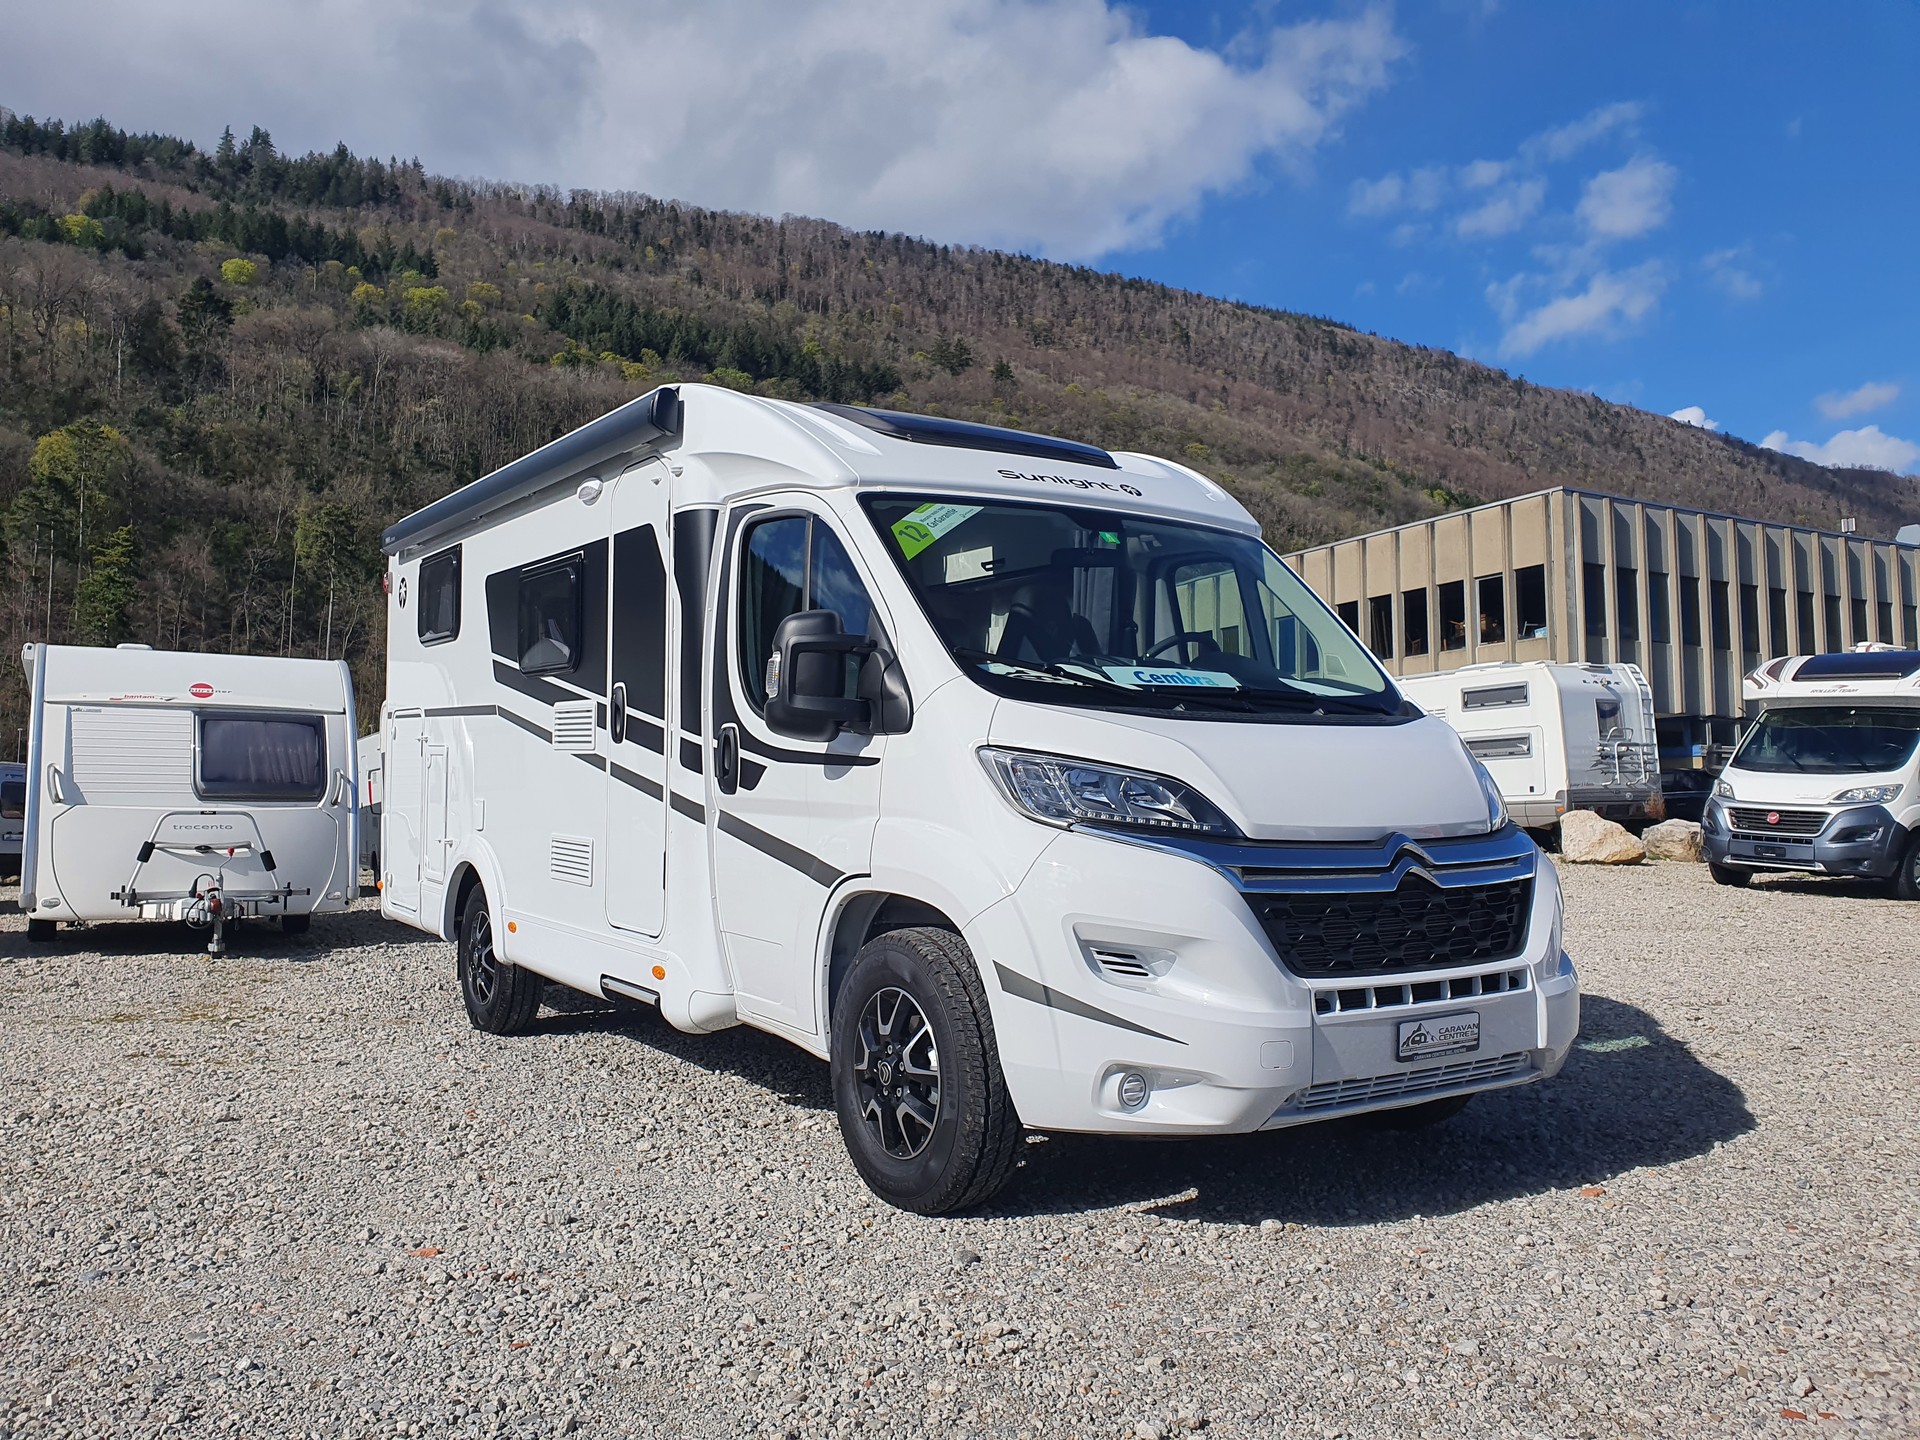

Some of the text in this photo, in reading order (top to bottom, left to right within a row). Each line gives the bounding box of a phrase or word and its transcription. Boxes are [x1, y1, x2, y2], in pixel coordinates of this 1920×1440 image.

[997, 469, 1119, 492] Sunlight
[898, 525, 930, 543] 12
[1133, 670, 1219, 687] Cembra
[1438, 1023, 1479, 1034] CARAVAN
[1438, 1030, 1470, 1041] CENTRE
